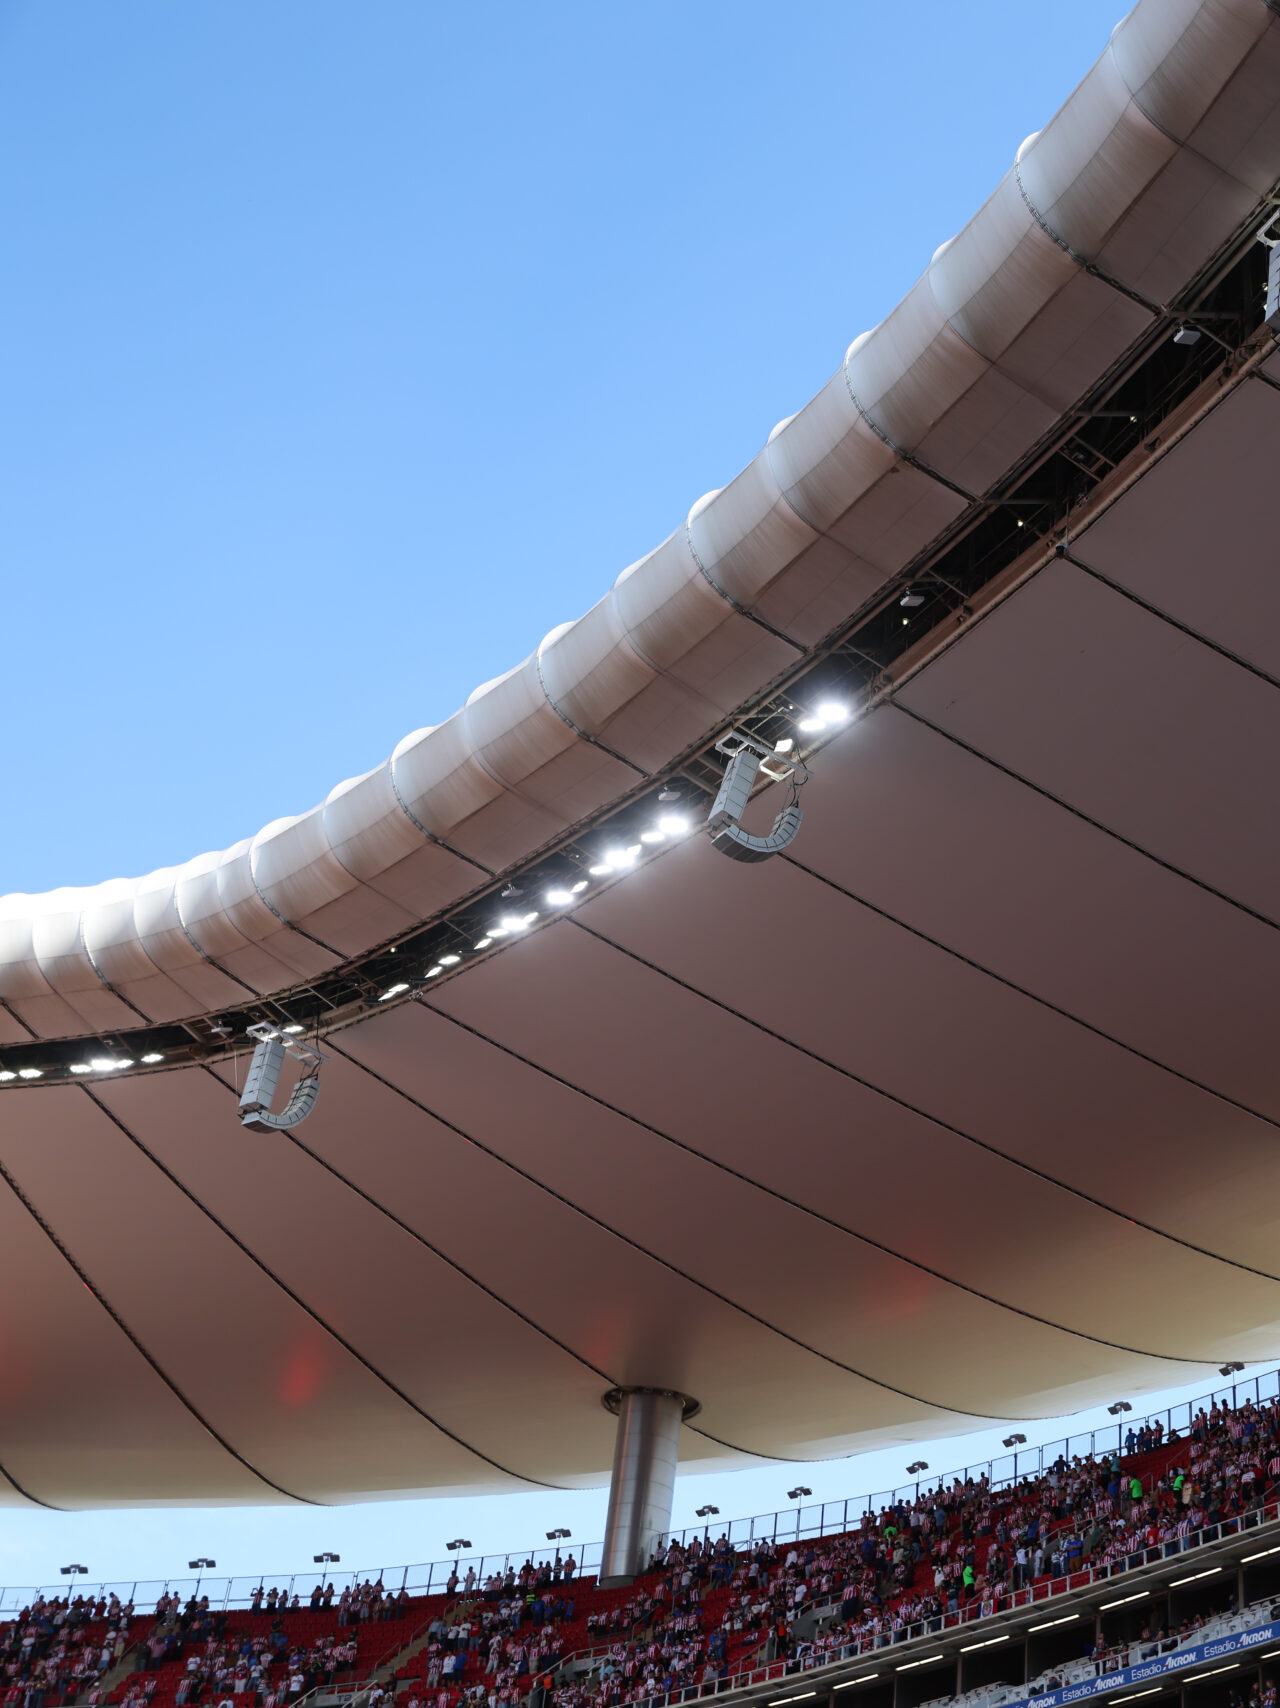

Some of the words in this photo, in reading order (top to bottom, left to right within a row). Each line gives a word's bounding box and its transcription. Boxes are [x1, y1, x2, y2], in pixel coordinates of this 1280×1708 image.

[1203, 1640, 1235, 1657] Estadio
[1237, 1628, 1272, 1647] AKRON
[1131, 1664, 1161, 1680] Estadio
[1163, 1652, 1196, 1670] AKRON
[1062, 1685, 1091, 1701] Estadio
[1092, 1674, 1124, 1692] AKRON
